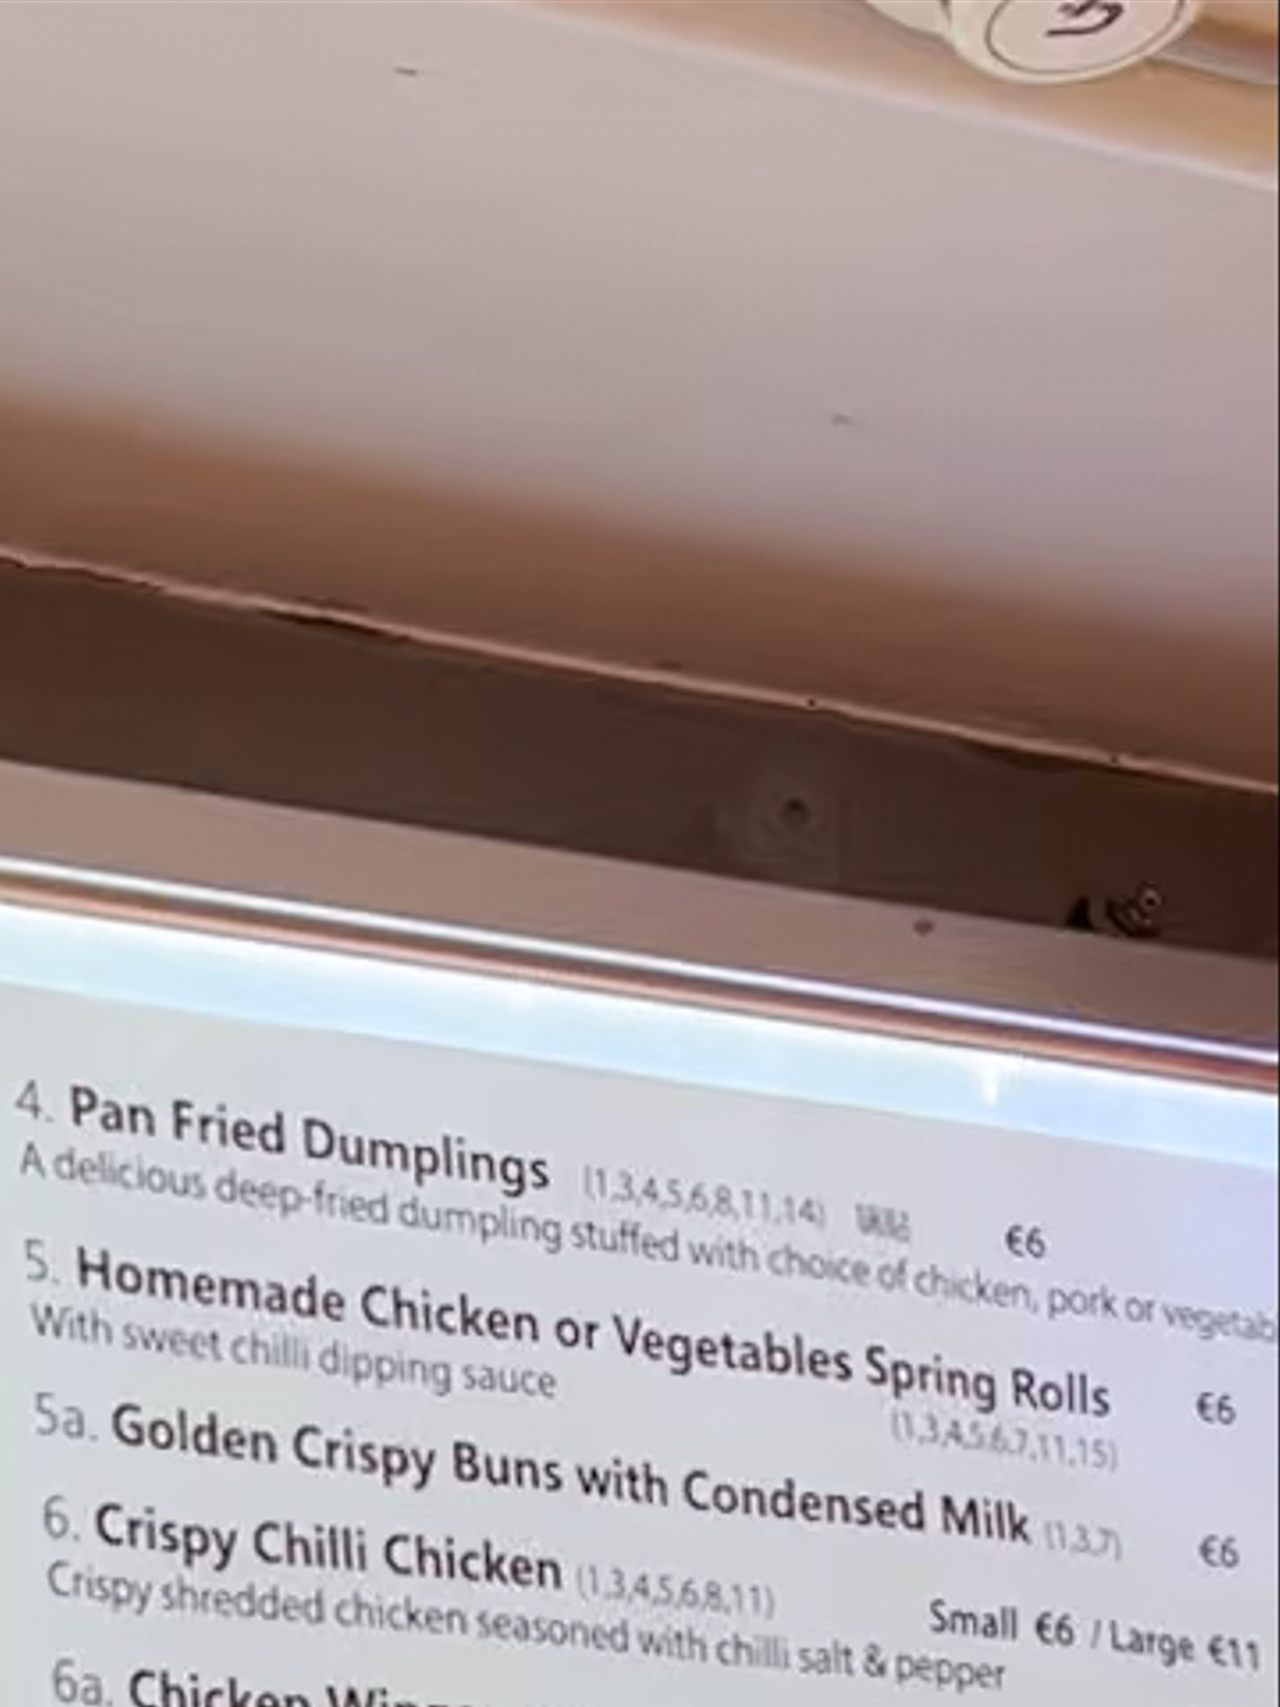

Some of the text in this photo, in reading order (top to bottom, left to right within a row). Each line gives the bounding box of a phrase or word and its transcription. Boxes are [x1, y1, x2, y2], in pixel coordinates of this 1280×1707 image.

[17, 1082, 548, 1196] 4. Pan Fried Dumplings
[1006, 1226, 1044, 1256] €6
[25, 1240, 1109, 1415] 5. Homemade Chicken or Vegetables Spring Rolls
[1197, 1394, 1234, 1422] €6
[36, 1394, 1030, 1542] 5a. Golden Crispy Buns with Condensed Milk
[44, 1497, 561, 1588] 6. Crispy Chilli Chicken
[1200, 1536, 1237, 1566] €6
[931, 1600, 1257, 1668] Small €6 Large €11
[53, 1660, 111, 1705] 6a.
